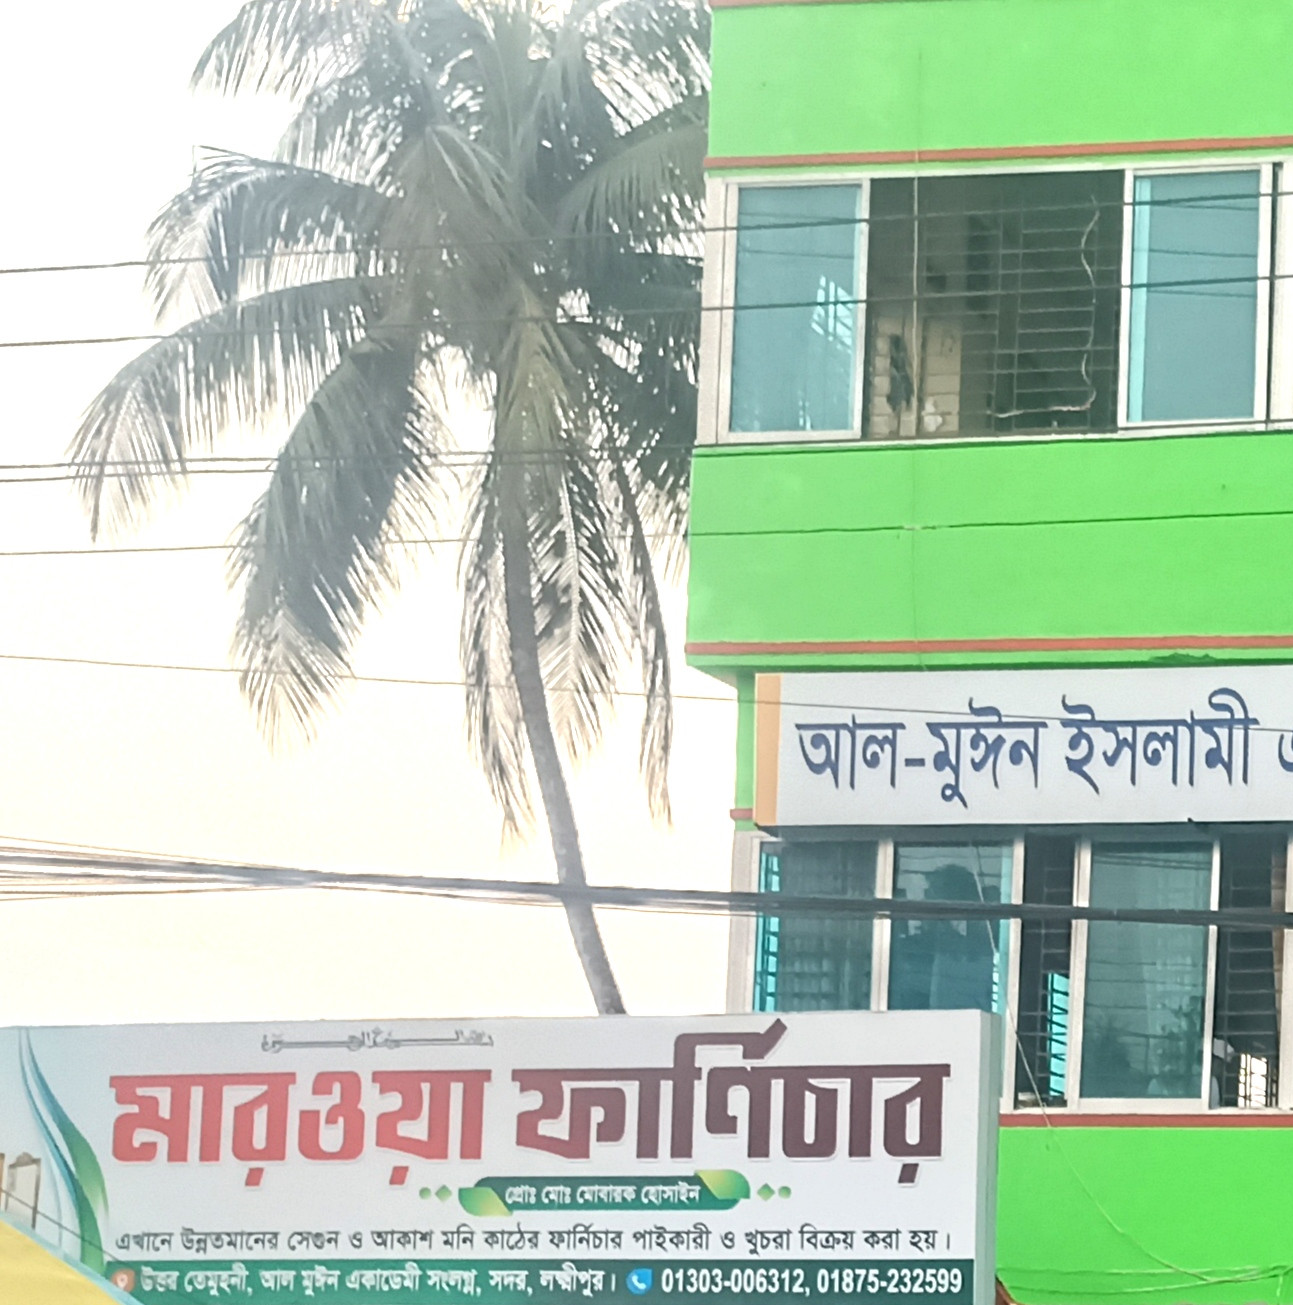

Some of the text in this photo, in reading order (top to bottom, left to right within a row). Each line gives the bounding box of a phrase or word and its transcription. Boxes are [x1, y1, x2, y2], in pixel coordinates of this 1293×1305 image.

[795, 696, 1048, 808] আল-মুঈন
[1060, 687, 1260, 795] ইসলামী
[109, 1069, 493, 1187] মারওয়া
[116, 1231, 173, 1251] এখানে
[181, 1227, 280, 1255] উন্নতমানের
[287, 1230, 341, 1251] সেগুন
[349, 1231, 363, 1250] ও
[371, 1229, 434, 1250] আকাশ
[441, 1223, 476, 1250] মনি
[483, 1221, 541, 1250] কাঠের
[549, 1223, 624, 1250] ফার্নিচার
[632, 1222, 712, 1252] পাইকারী
[720, 1231, 735, 1250] ও
[745, 1229, 792, 1255] খুচরা
[798, 1223, 856, 1250] বিক্রয়
[863, 1229, 901, 1250] করা
[909, 1229, 938, 1252] হয়
[259, 1269, 296, 1291] আল
[301, 1265, 341, 1296] মুঈন
[346, 1261, 422, 1291] একাডেমী
[489, 1269, 533, 1296] সদর,
[540, 1261, 605, 1298] লক্ষ্মীপুর
[661, 1267, 810, 1297] 01303-006312,
[817, 1267, 963, 1294] 01875-232599
